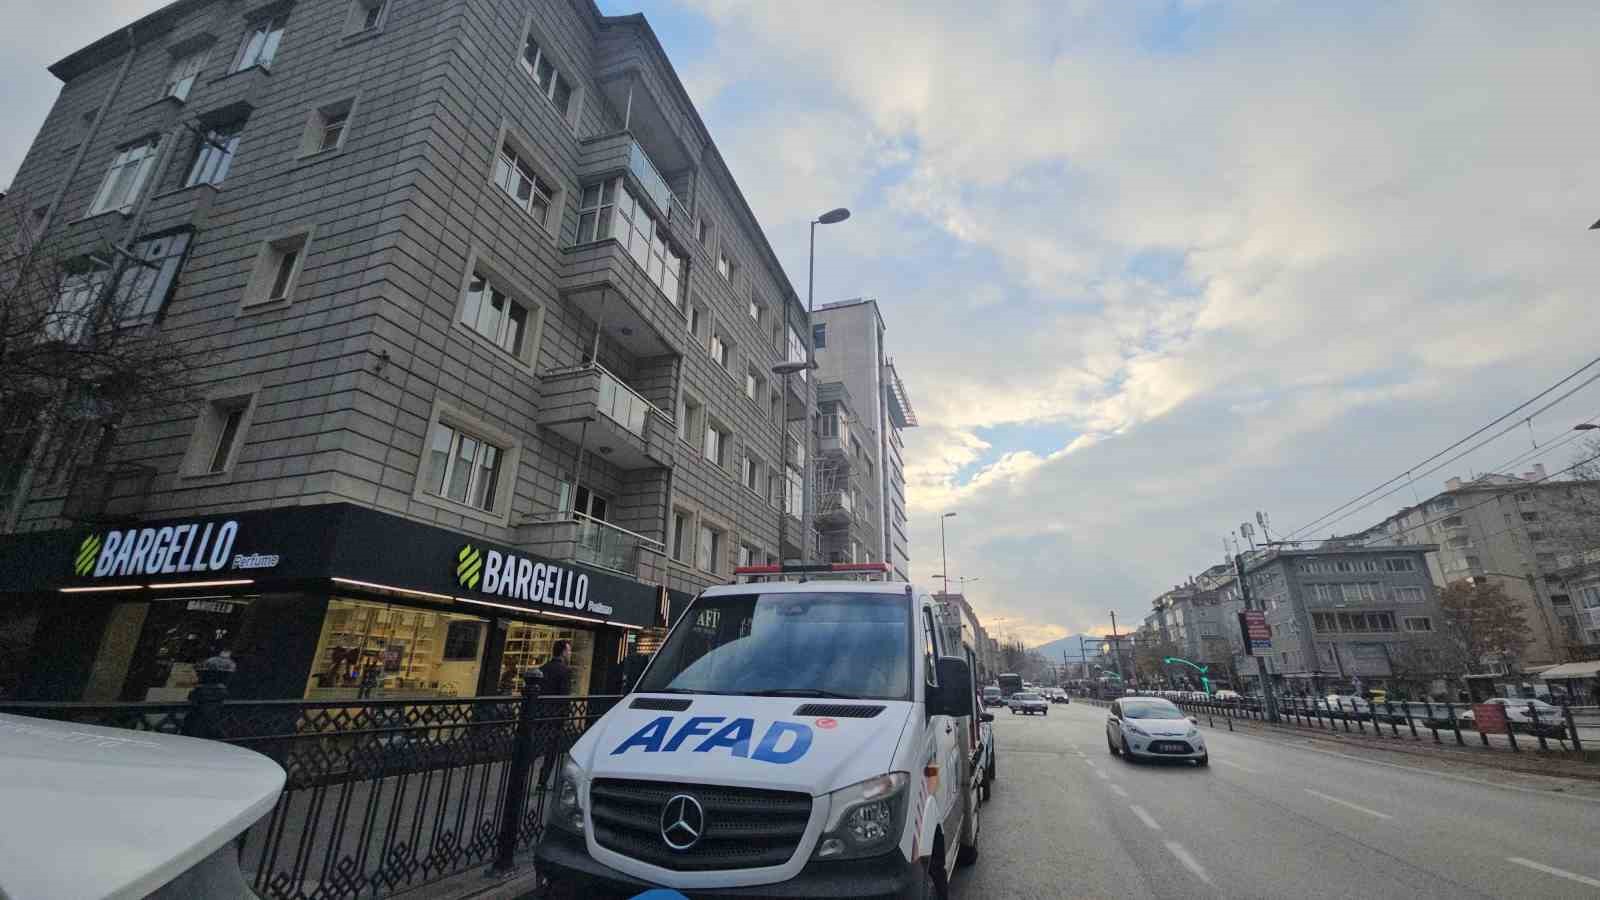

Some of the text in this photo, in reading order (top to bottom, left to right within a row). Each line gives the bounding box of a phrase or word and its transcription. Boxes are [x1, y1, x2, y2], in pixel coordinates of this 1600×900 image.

[93, 520, 238, 577] BARGELLO
[481, 550, 589, 610] BARGELLO
[609, 716, 814, 764] AFAD
